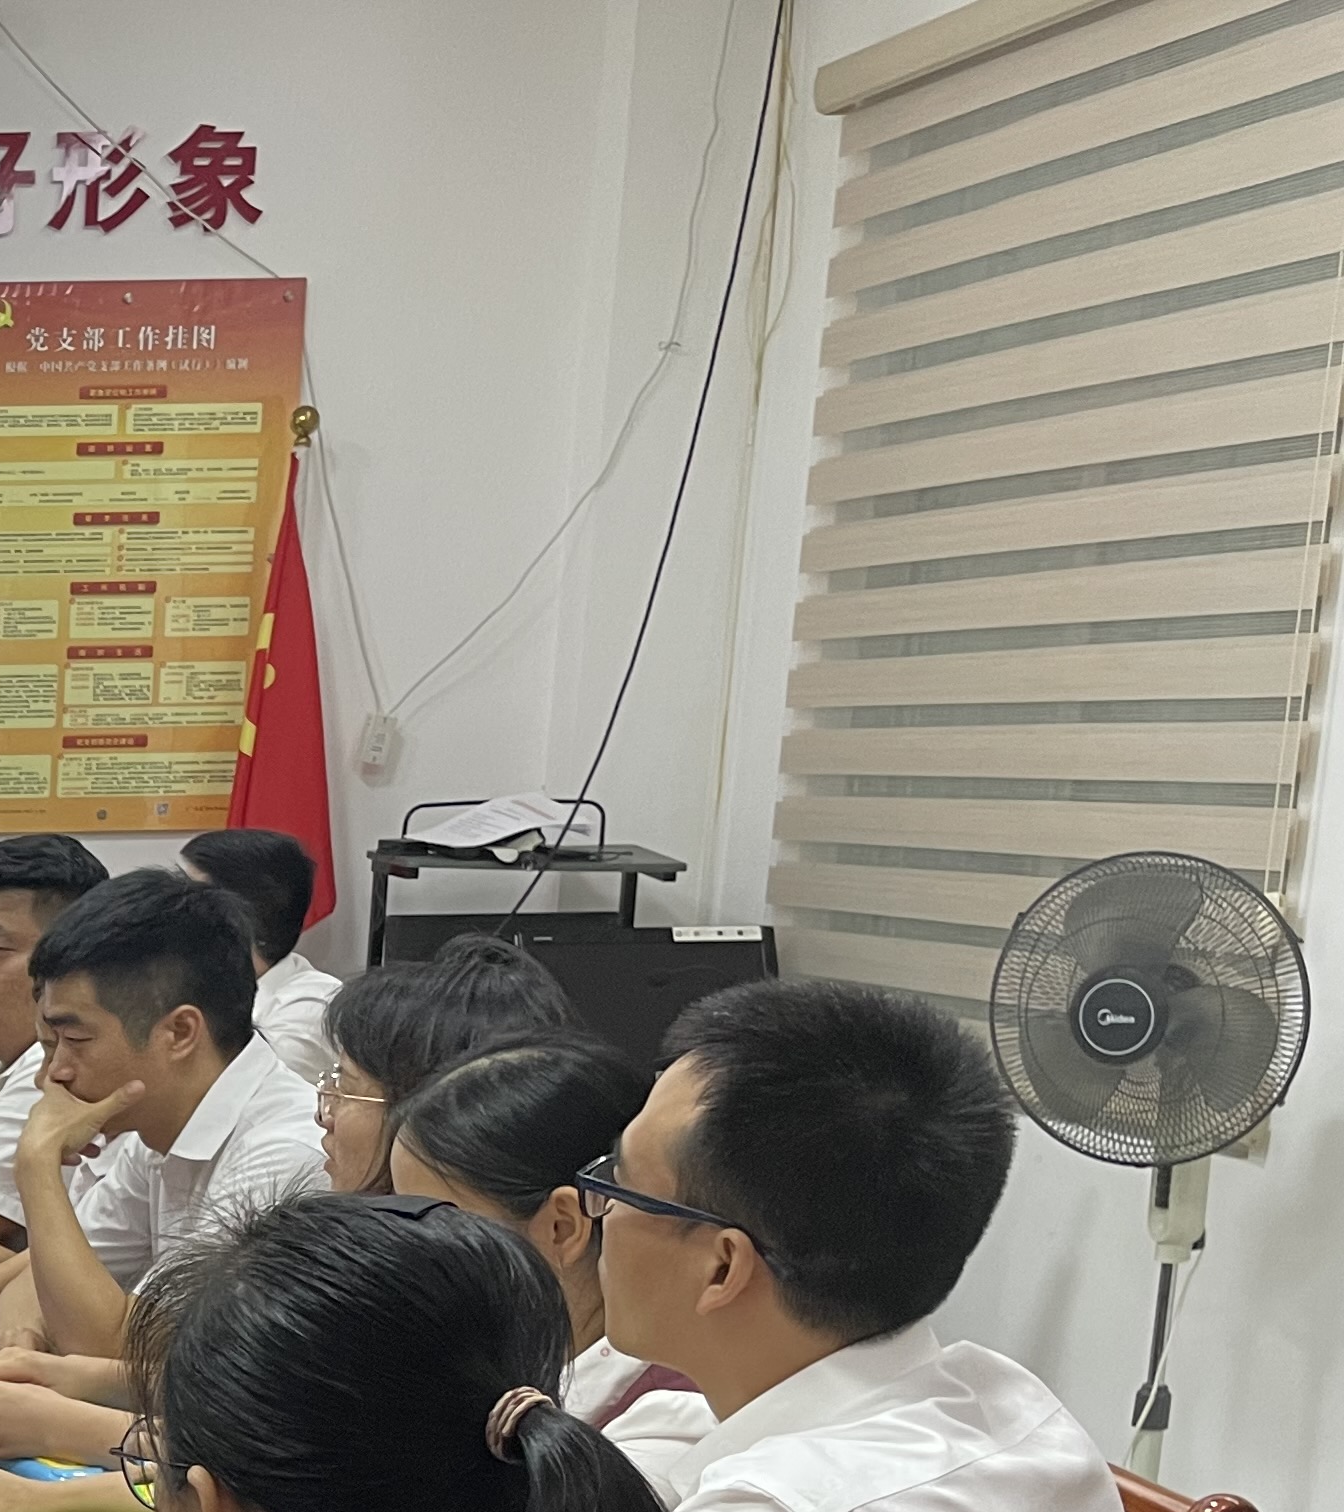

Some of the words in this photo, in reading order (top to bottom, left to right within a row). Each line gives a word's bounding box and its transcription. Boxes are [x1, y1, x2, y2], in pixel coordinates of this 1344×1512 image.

[26, 325, 216, 352] 党支部工作挂图
